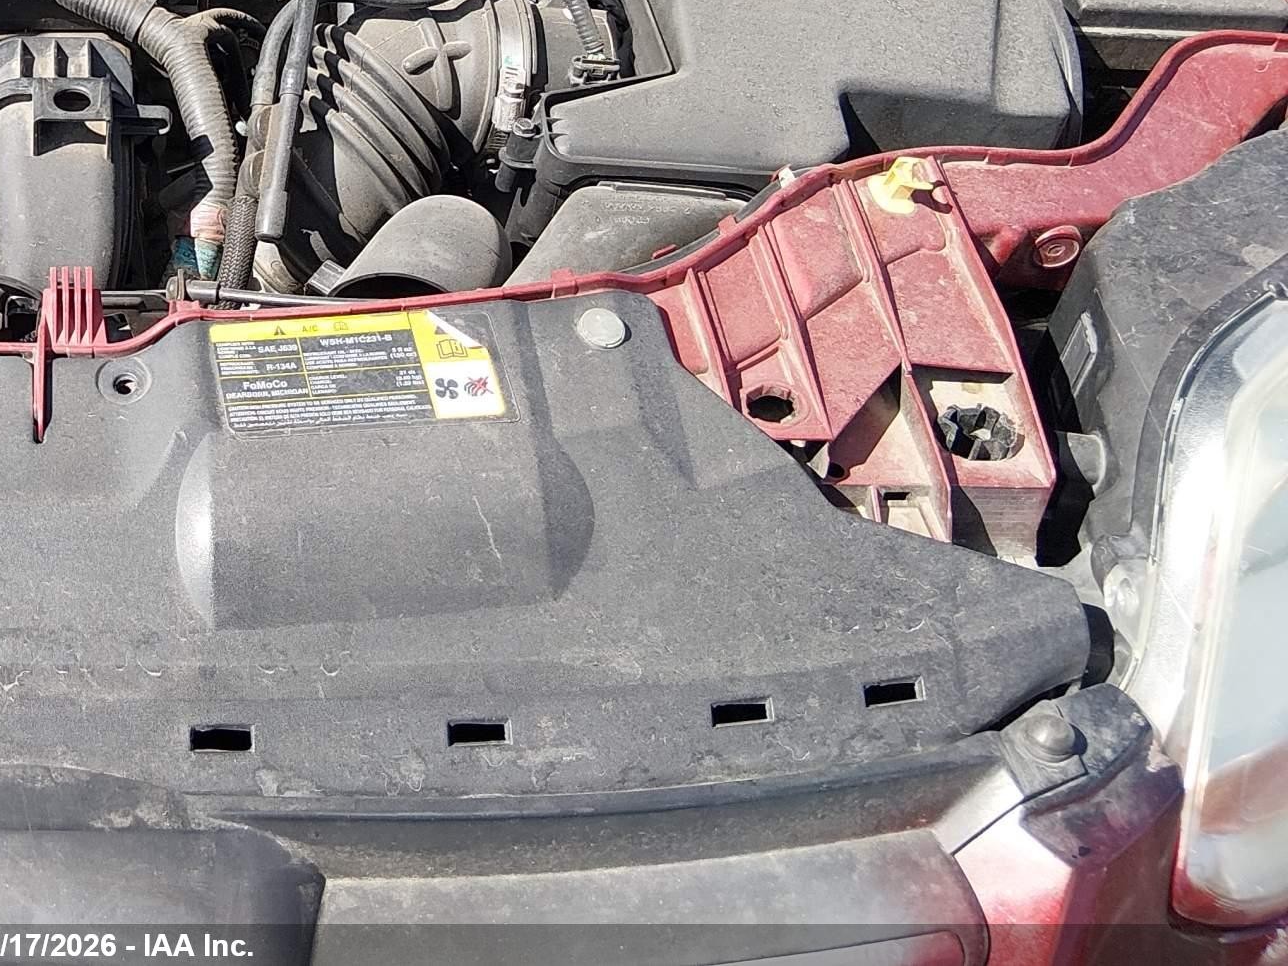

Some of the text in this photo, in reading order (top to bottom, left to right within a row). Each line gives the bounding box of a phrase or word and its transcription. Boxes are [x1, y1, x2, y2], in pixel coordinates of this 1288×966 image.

[302, 324, 319, 333] A/C
[265, 361, 298, 371] R-134A
[242, 379, 288, 390] FoMoCo
